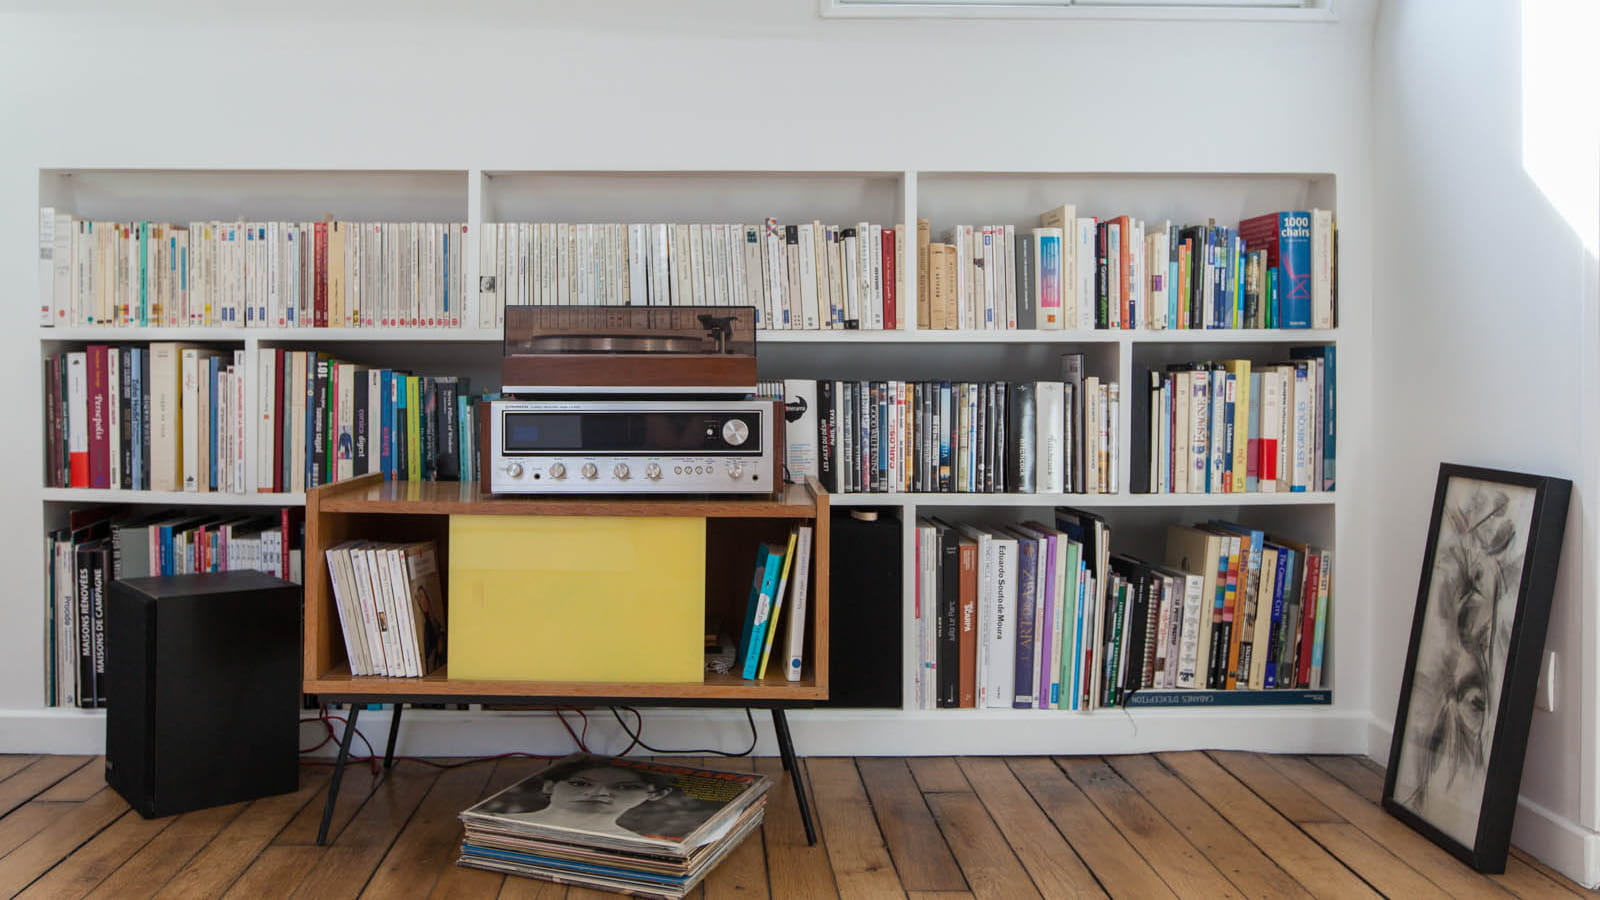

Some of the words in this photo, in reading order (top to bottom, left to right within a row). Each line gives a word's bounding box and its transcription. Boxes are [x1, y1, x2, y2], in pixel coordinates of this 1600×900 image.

[1281, 226, 1310, 237] chairs
[1284, 217, 1308, 226] 1000
[317, 362, 328, 379] 101
[92, 393, 104, 440] Persepolis
[998, 545, 1006, 578] Eduardo
[79, 568, 88, 614] RÉNOVÉES
[94, 568, 103, 618] CAMPAGNE
[997, 579, 1005, 604] Souto
[997, 604, 1004, 614] de
[82, 615, 90, 656] MAISONS
[96, 619, 103, 631] DE
[996, 614, 1004, 640] Moura
[96, 632, 105, 674] MAISONS
